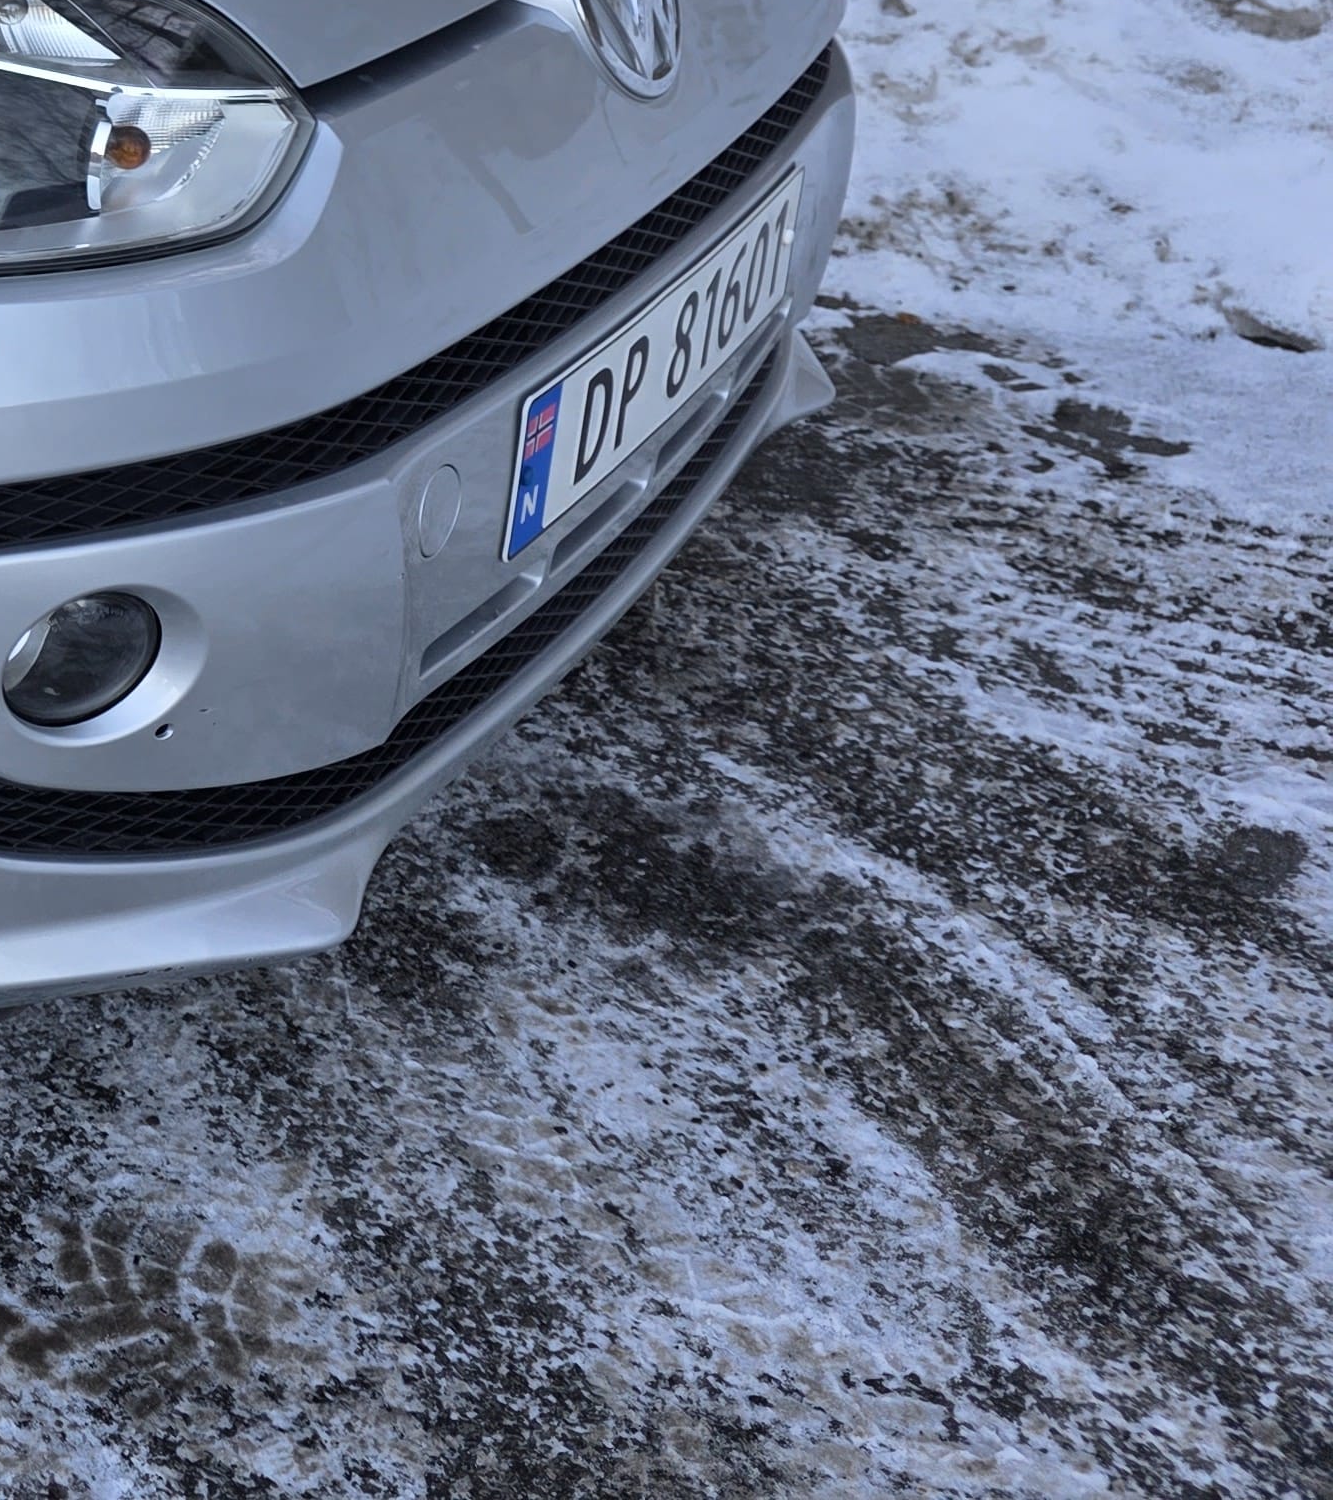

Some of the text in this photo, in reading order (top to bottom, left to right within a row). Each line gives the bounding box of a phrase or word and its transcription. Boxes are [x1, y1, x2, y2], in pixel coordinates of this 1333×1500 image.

[573, 199, 790, 486] DP 81601
[519, 484, 539, 525] N
